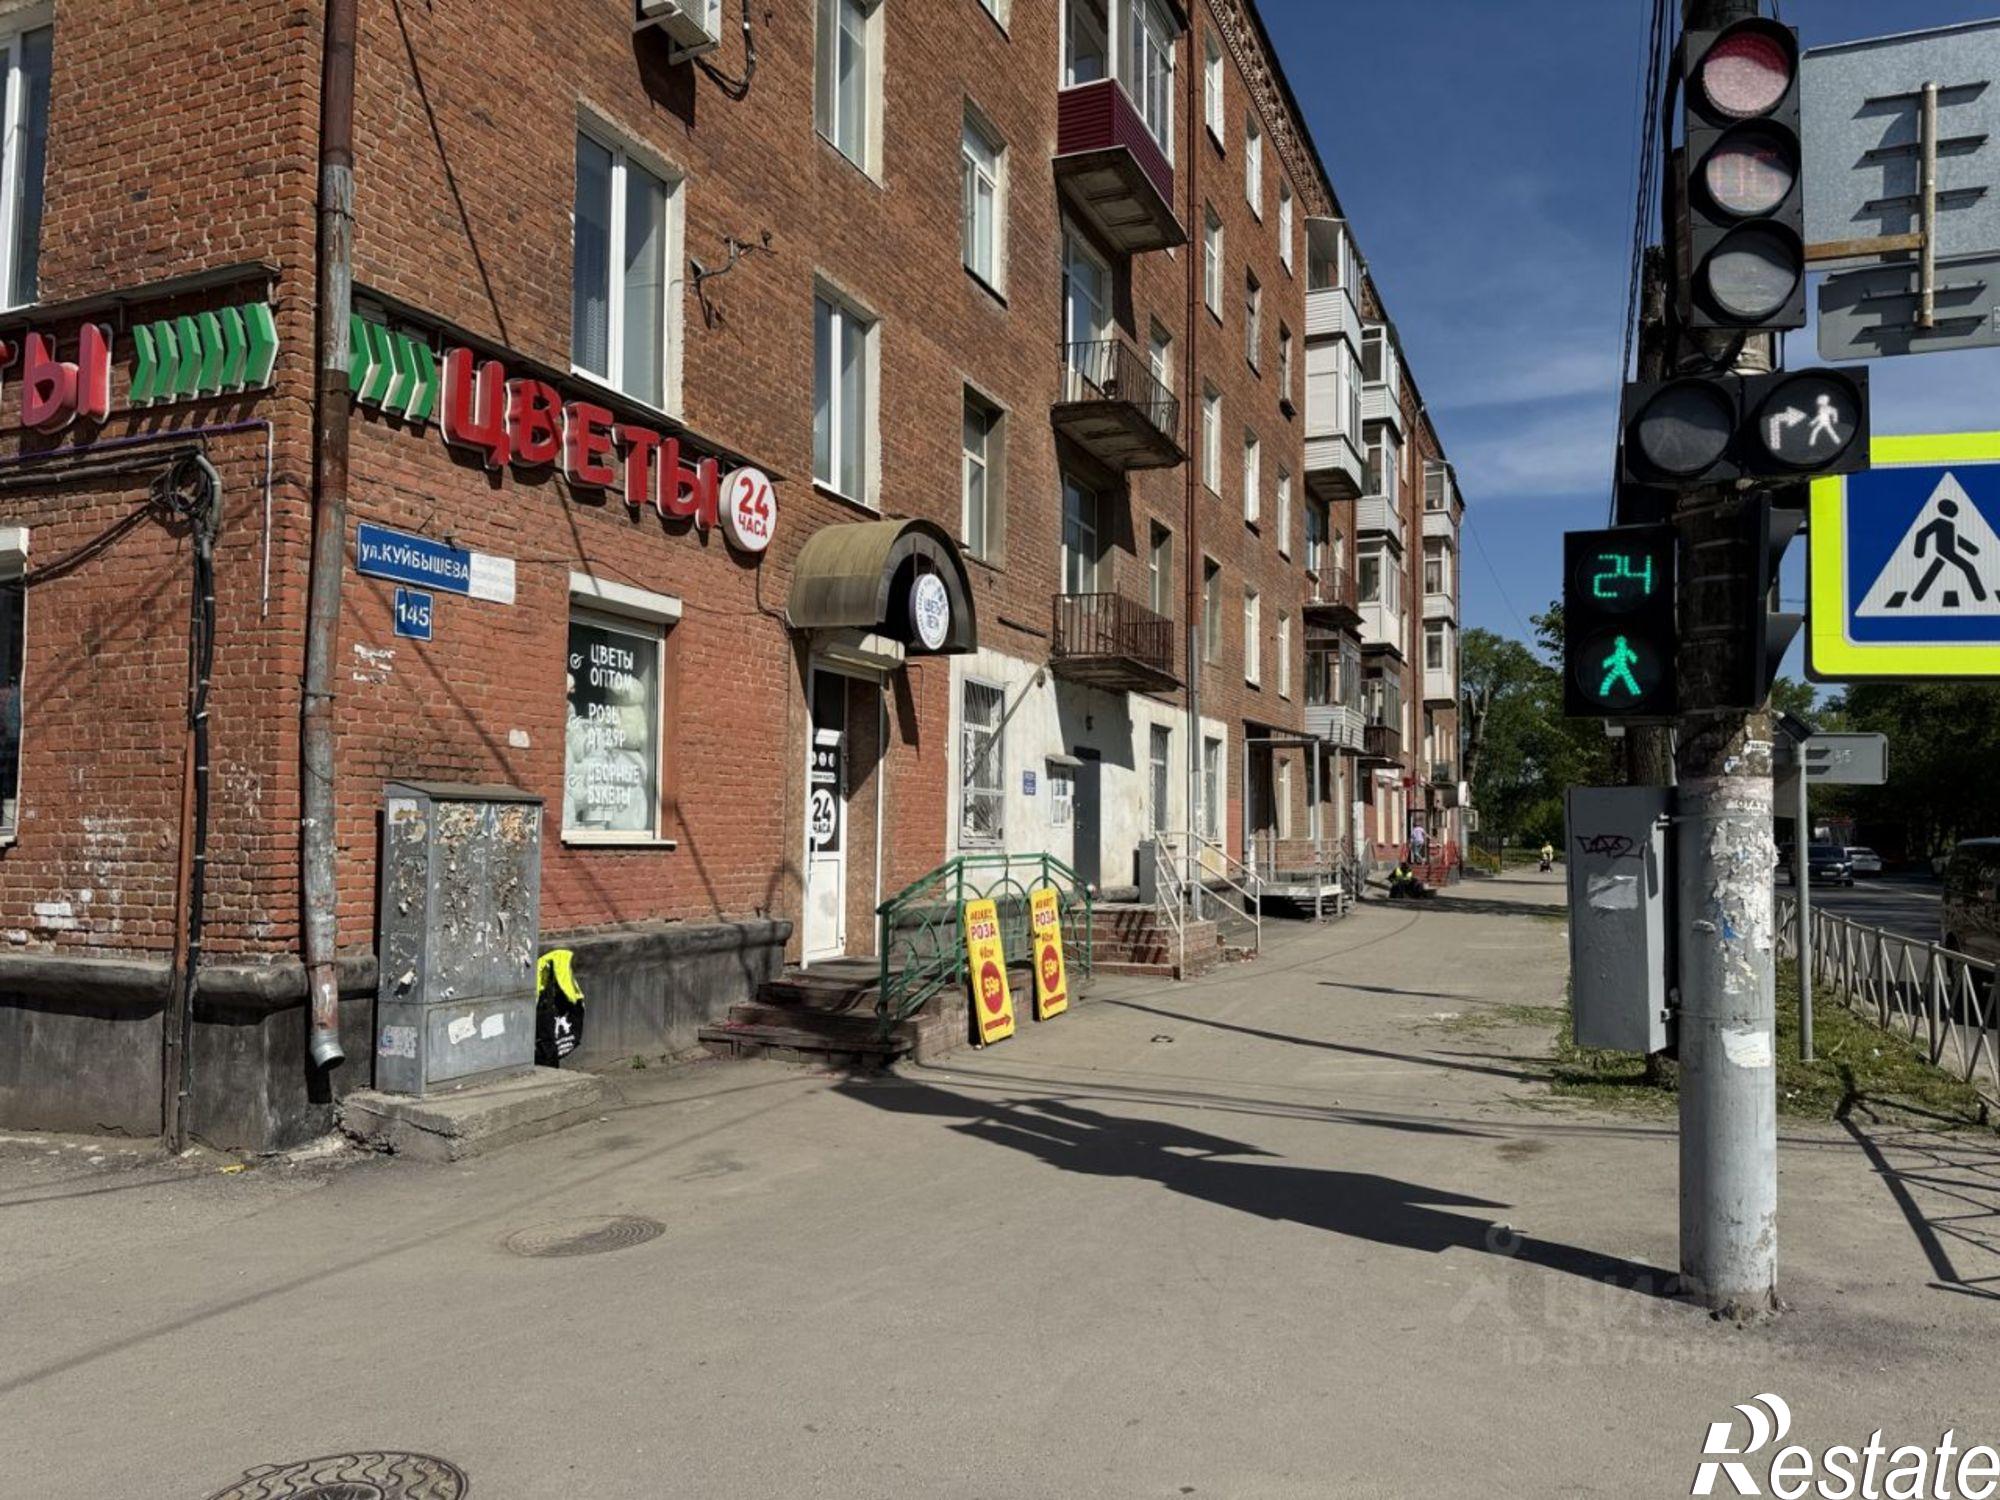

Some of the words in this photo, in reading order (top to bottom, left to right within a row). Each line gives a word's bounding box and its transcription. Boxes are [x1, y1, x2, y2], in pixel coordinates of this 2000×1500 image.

[0, 322, 112, 431] Ы
[441, 347, 721, 530] ЦВЕТЫ
[738, 476, 770, 521] 24
[738, 514, 768, 538] ЧАСА
[1593, 554, 1653, 598] 24
[398, 603, 430, 627] 145
[590, 643, 634, 671] ЦВЕТЫ
[590, 668, 633, 691] ОПТОМ
[812, 797, 832, 823] 24
[1035, 910, 1056, 926] РОЗА
[970, 922, 997, 941] РОЗА
